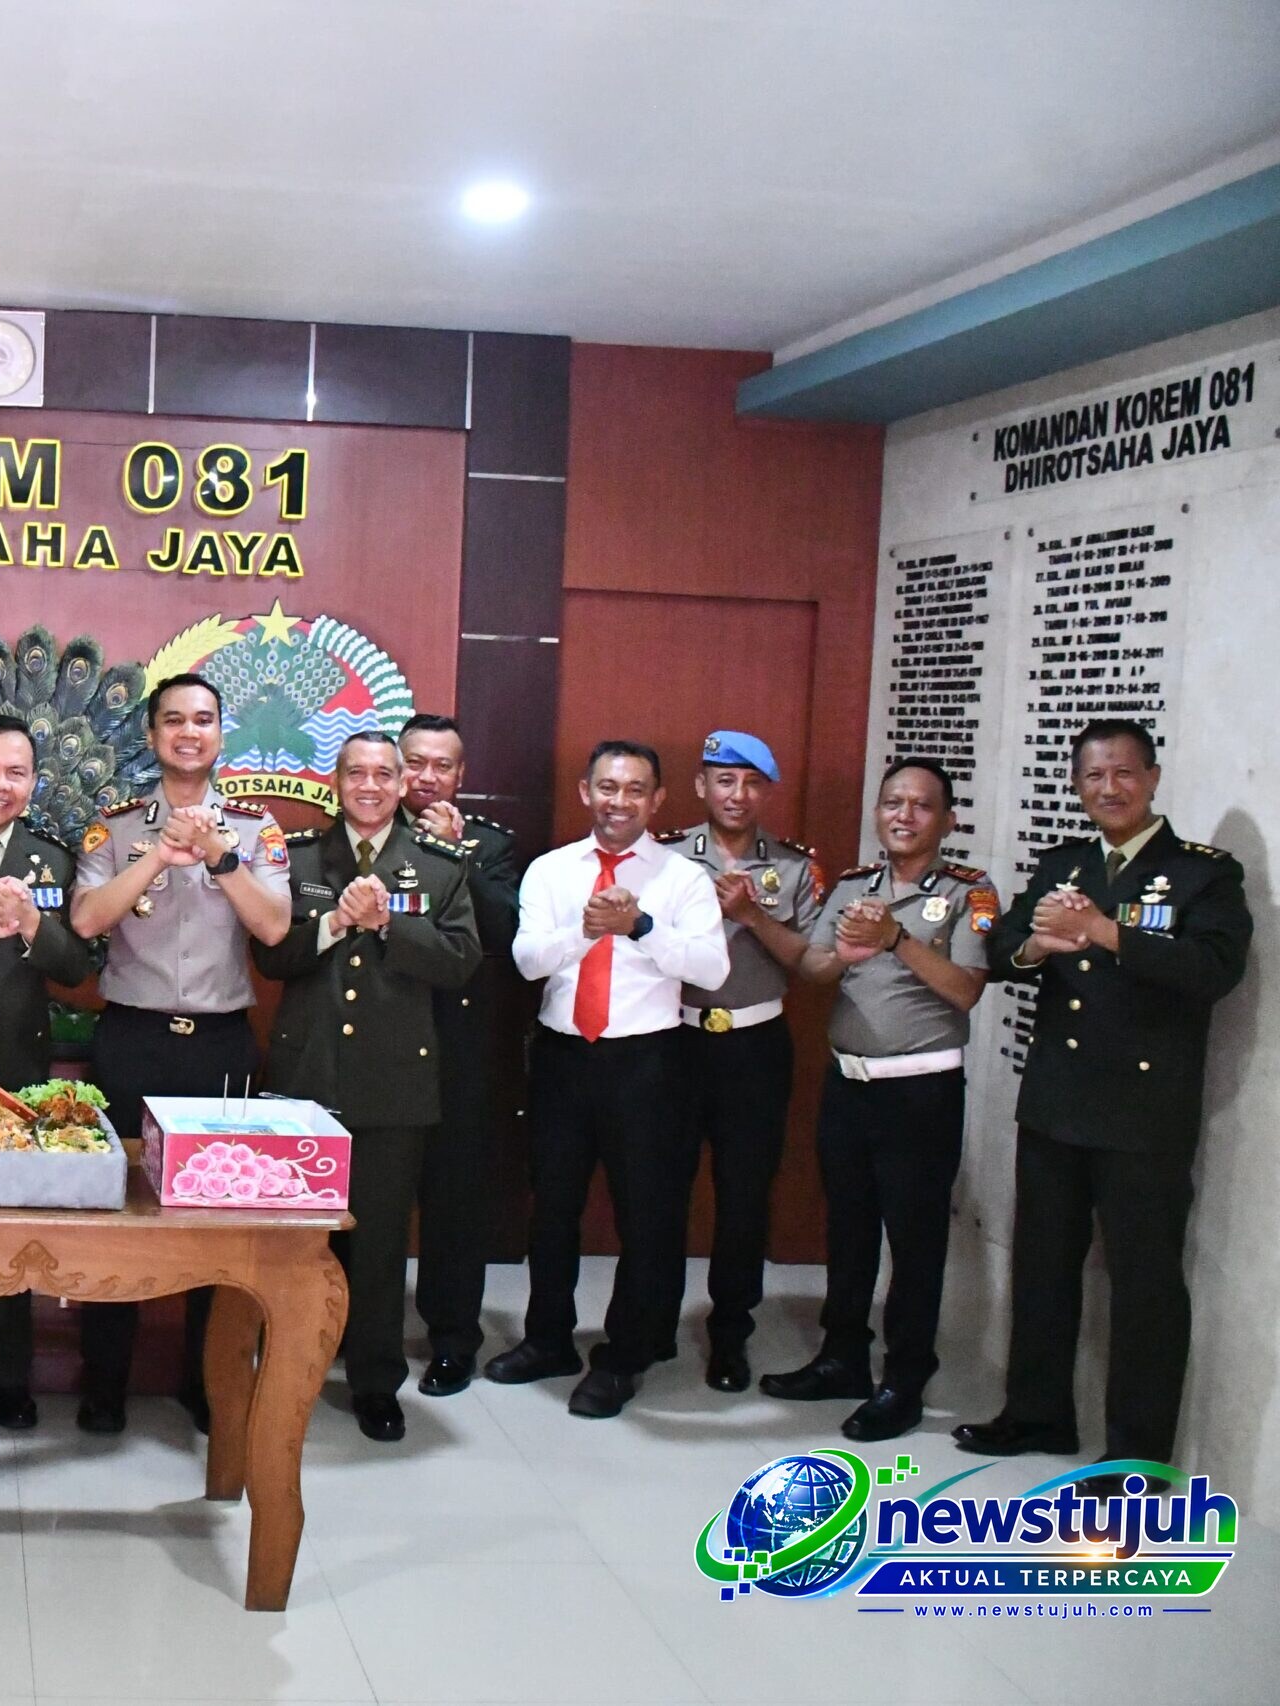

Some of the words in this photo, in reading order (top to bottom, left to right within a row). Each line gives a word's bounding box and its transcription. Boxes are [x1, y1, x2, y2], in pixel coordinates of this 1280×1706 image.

[993, 400, 1109, 461] KOMANDAN
[1115, 377, 1202, 434] KOREM
[1209, 361, 1256, 411] 081
[124, 438, 310, 521] 081
[1004, 432, 1154, 493] DHIROTSAHA
[1162, 415, 1231, 461] JAYA
[146, 526, 306, 580] JAYA
[214, 778, 305, 797] ROTSAHA
[311, 788, 334, 804] JA
